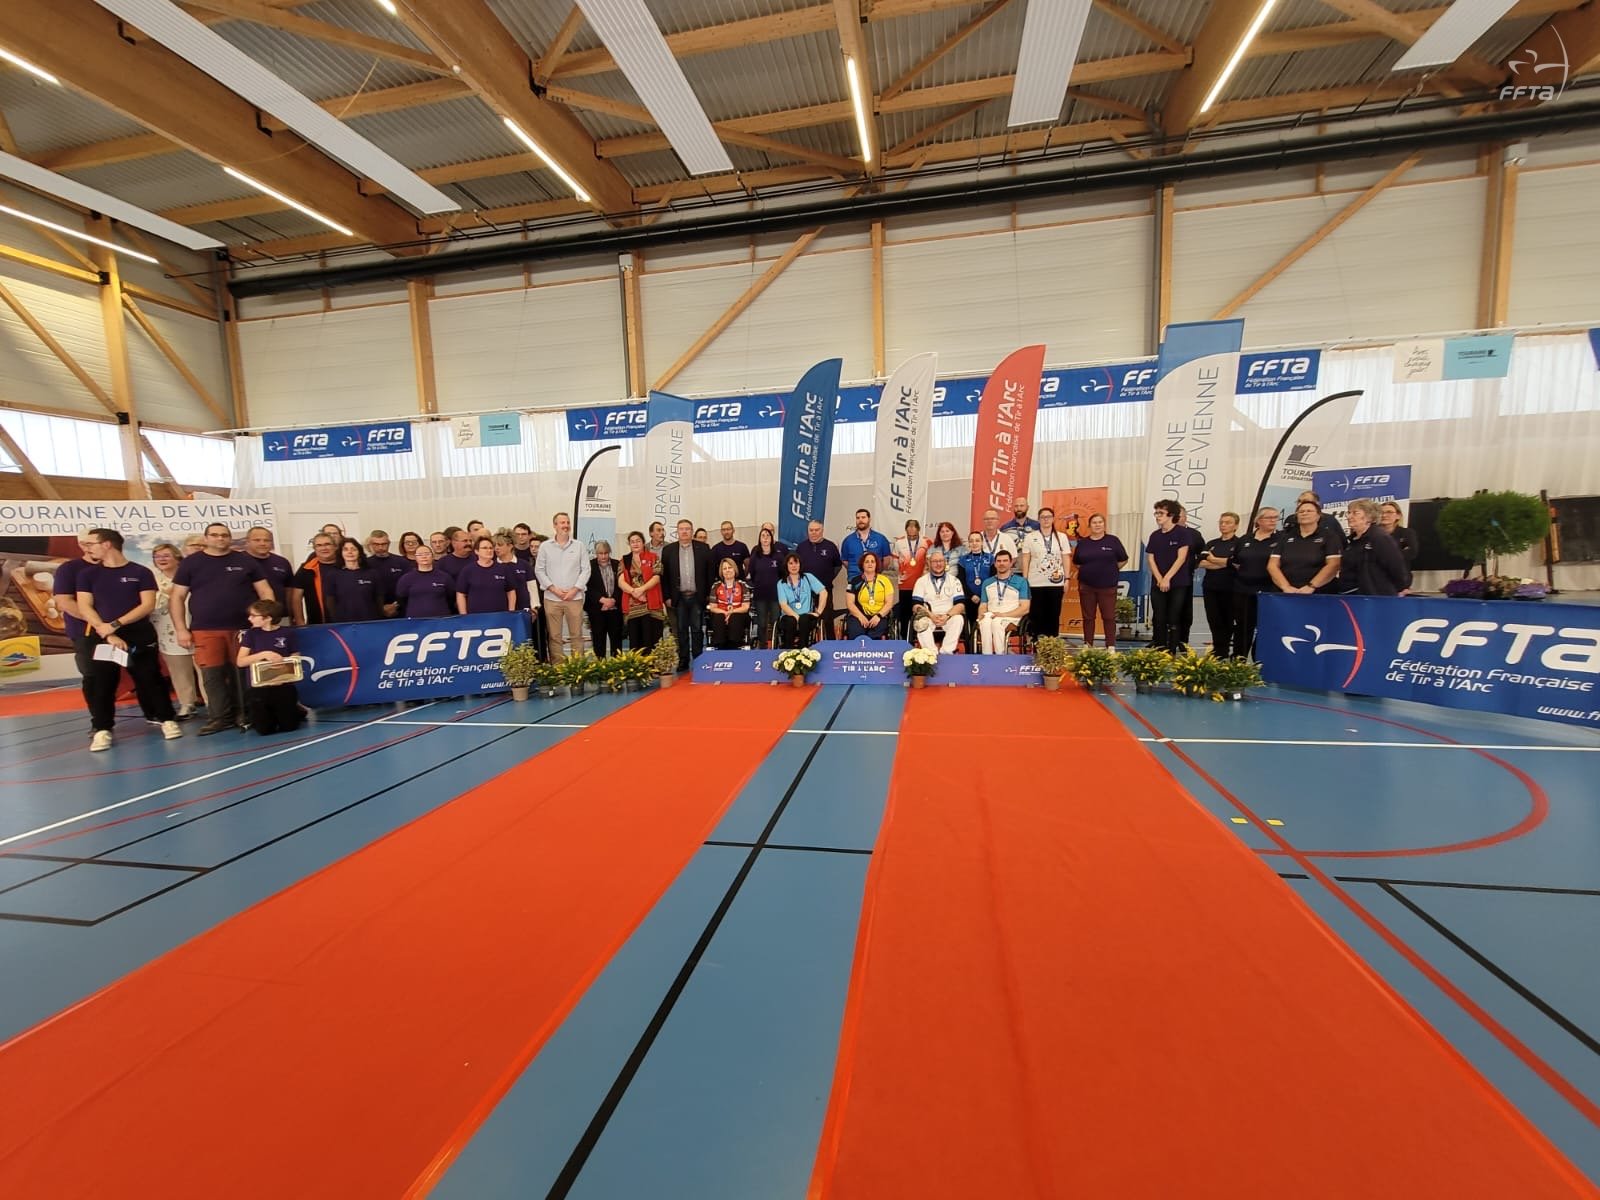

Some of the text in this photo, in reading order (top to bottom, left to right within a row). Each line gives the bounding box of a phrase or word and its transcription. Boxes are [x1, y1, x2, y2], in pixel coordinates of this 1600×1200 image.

[1190, 366, 1220, 453] VIENNE
[797, 443, 811, 456] à
[893, 436, 908, 448] à
[670, 428, 684, 490] VIENNE
[892, 452, 907, 478] Tir
[992, 449, 1009, 475] Tir
[1162, 421, 1187, 501] URAINE
[794, 457, 810, 485] Tir
[1187, 458, 1208, 487] DE
[1282, 468, 1312, 478] TOURA
[655, 464, 668, 526] URAINE
[669, 495, 681, 515] DE
[791, 489, 806, 520] FF
[890, 483, 905, 512] FF
[989, 480, 1006, 511] FF
[0, 502, 273, 519] OURAINE VAL DE VIENNE
[138, 519, 164, 532] de
[860, 639, 865, 647] 1
[754, 660, 762, 670] 2
[833, 651, 895, 660] CHAMPIONNAT
[380, 665, 446, 680] Fédération
[842, 665, 856, 673] TIR
[971, 663, 980, 674] 3
[1389, 658, 1596, 692] Fédération Française
[378, 675, 455, 689] de Tir à l'Arc
[1385, 670, 1495, 693] de Tir à l'Arc
